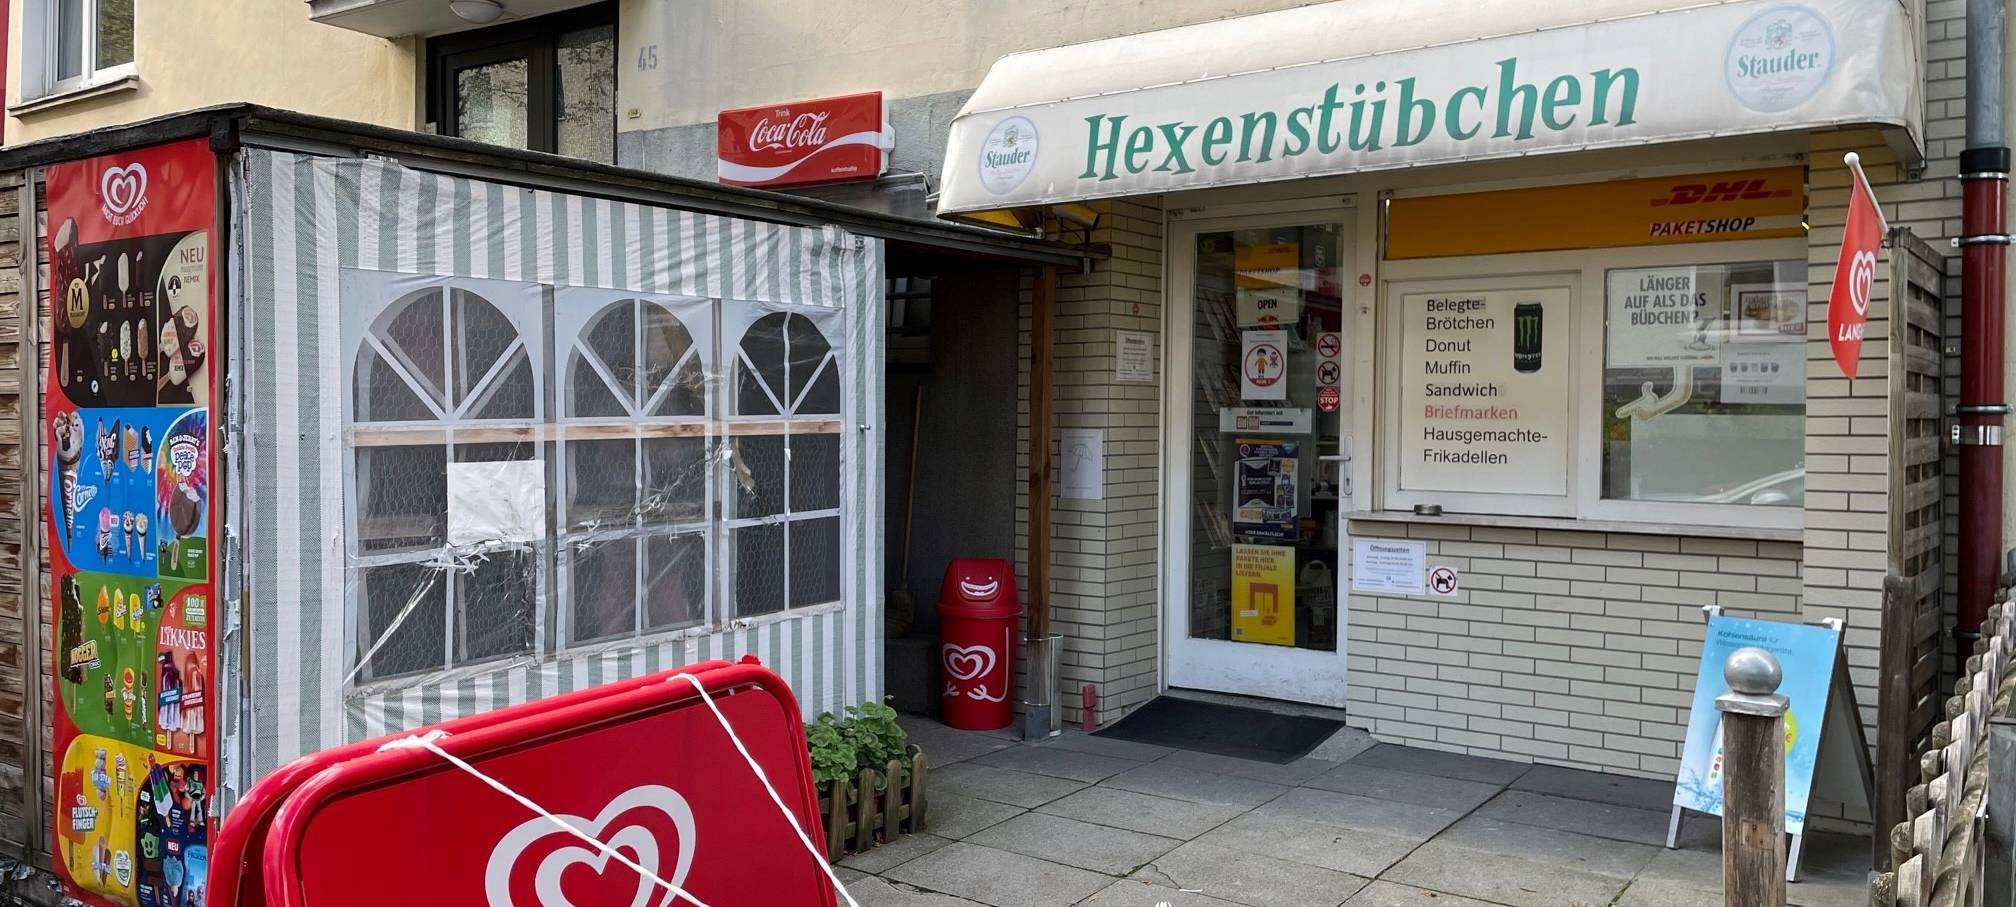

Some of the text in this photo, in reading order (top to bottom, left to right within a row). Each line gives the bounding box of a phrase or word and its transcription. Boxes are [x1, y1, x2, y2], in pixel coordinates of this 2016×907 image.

[636, 45, 658, 72] 45
[1736, 48, 1820, 79] Stauder
[1078, 56, 1640, 181] Hexenstübchen
[749, 110, 831, 152] Coca-Cola
[984, 147, 1031, 169] Stauder
[1667, 179, 1772, 206] DHL
[1650, 217, 1756, 237] PAKETSHOP
[180, 246, 204, 264] NEU
[1639, 275, 1690, 292] LÄNGER
[1257, 298, 1278, 310] OPEN
[1426, 297, 1486, 314] Belegte-
[1624, 293, 1707, 310] AUF ALS DAS
[1426, 316, 1495, 330] Brötchen
[1631, 309, 1699, 326] BÜDCHEN?
[1426, 338, 1471, 353] Donut
[1425, 361, 1471, 375] Muffin
[1425, 383, 1498, 397] Sandwich
[1320, 397, 1339, 405] STOP
[1424, 405, 1518, 420] Briefmarken
[1424, 427, 1548, 444] Hausgemachte-
[174, 451, 195, 463] peace
[1424, 449, 1507, 464] Frikadellen
[177, 460, 192, 472] pop
[1369, 544, 1410, 554] Öffnungszeiten
[186, 596, 200, 608] 100
[160, 625, 206, 650] LIKKIES
[1717, 630, 1768, 642] Kohlensäure
[72, 806, 99, 819] FLUTSCH-
[72, 819, 95, 831] FINGER
[168, 841, 180, 852] NEU
